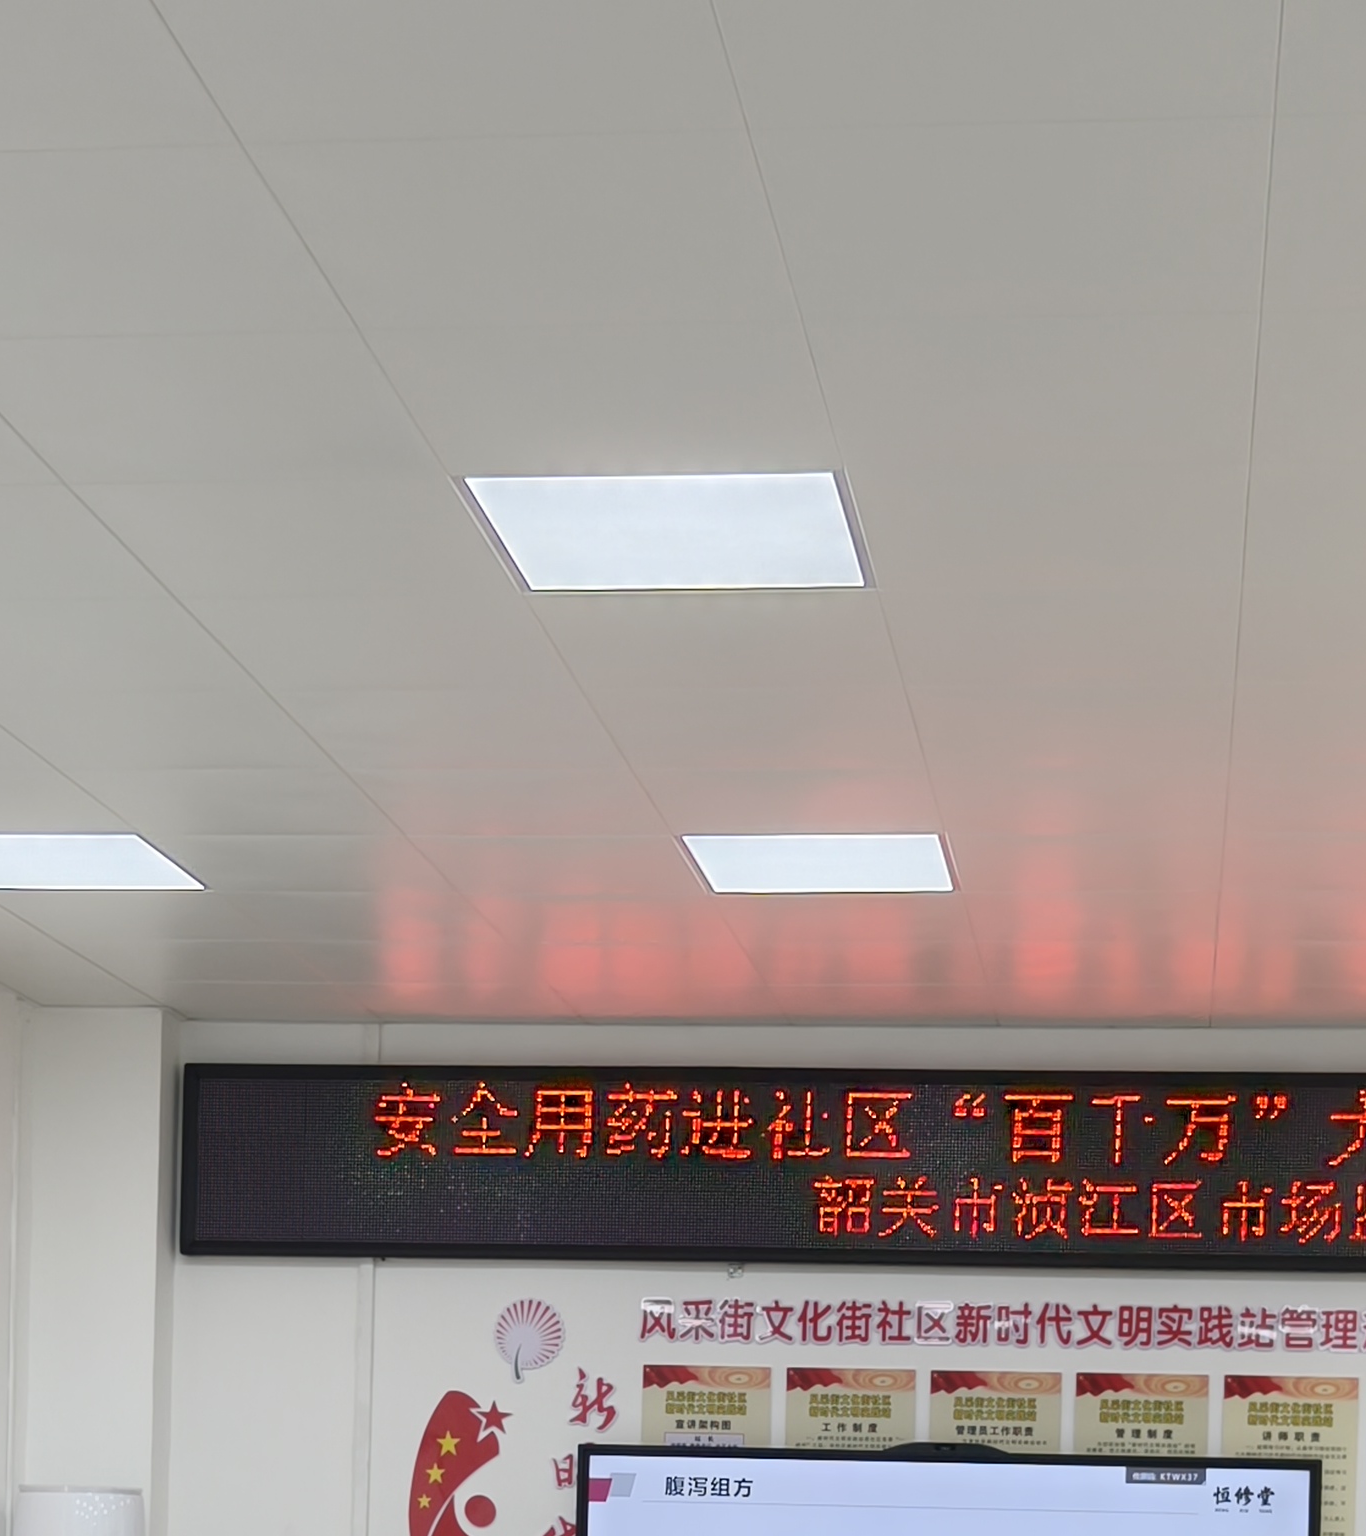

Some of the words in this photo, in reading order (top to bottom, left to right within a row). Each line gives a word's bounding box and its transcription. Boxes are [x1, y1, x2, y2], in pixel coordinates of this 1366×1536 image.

[822, 1422, 878, 1433] 工作制度
[664, 1476, 754, 1498] 腹泻组方
[1213, 1486, 1276, 1507] 恒修堂
